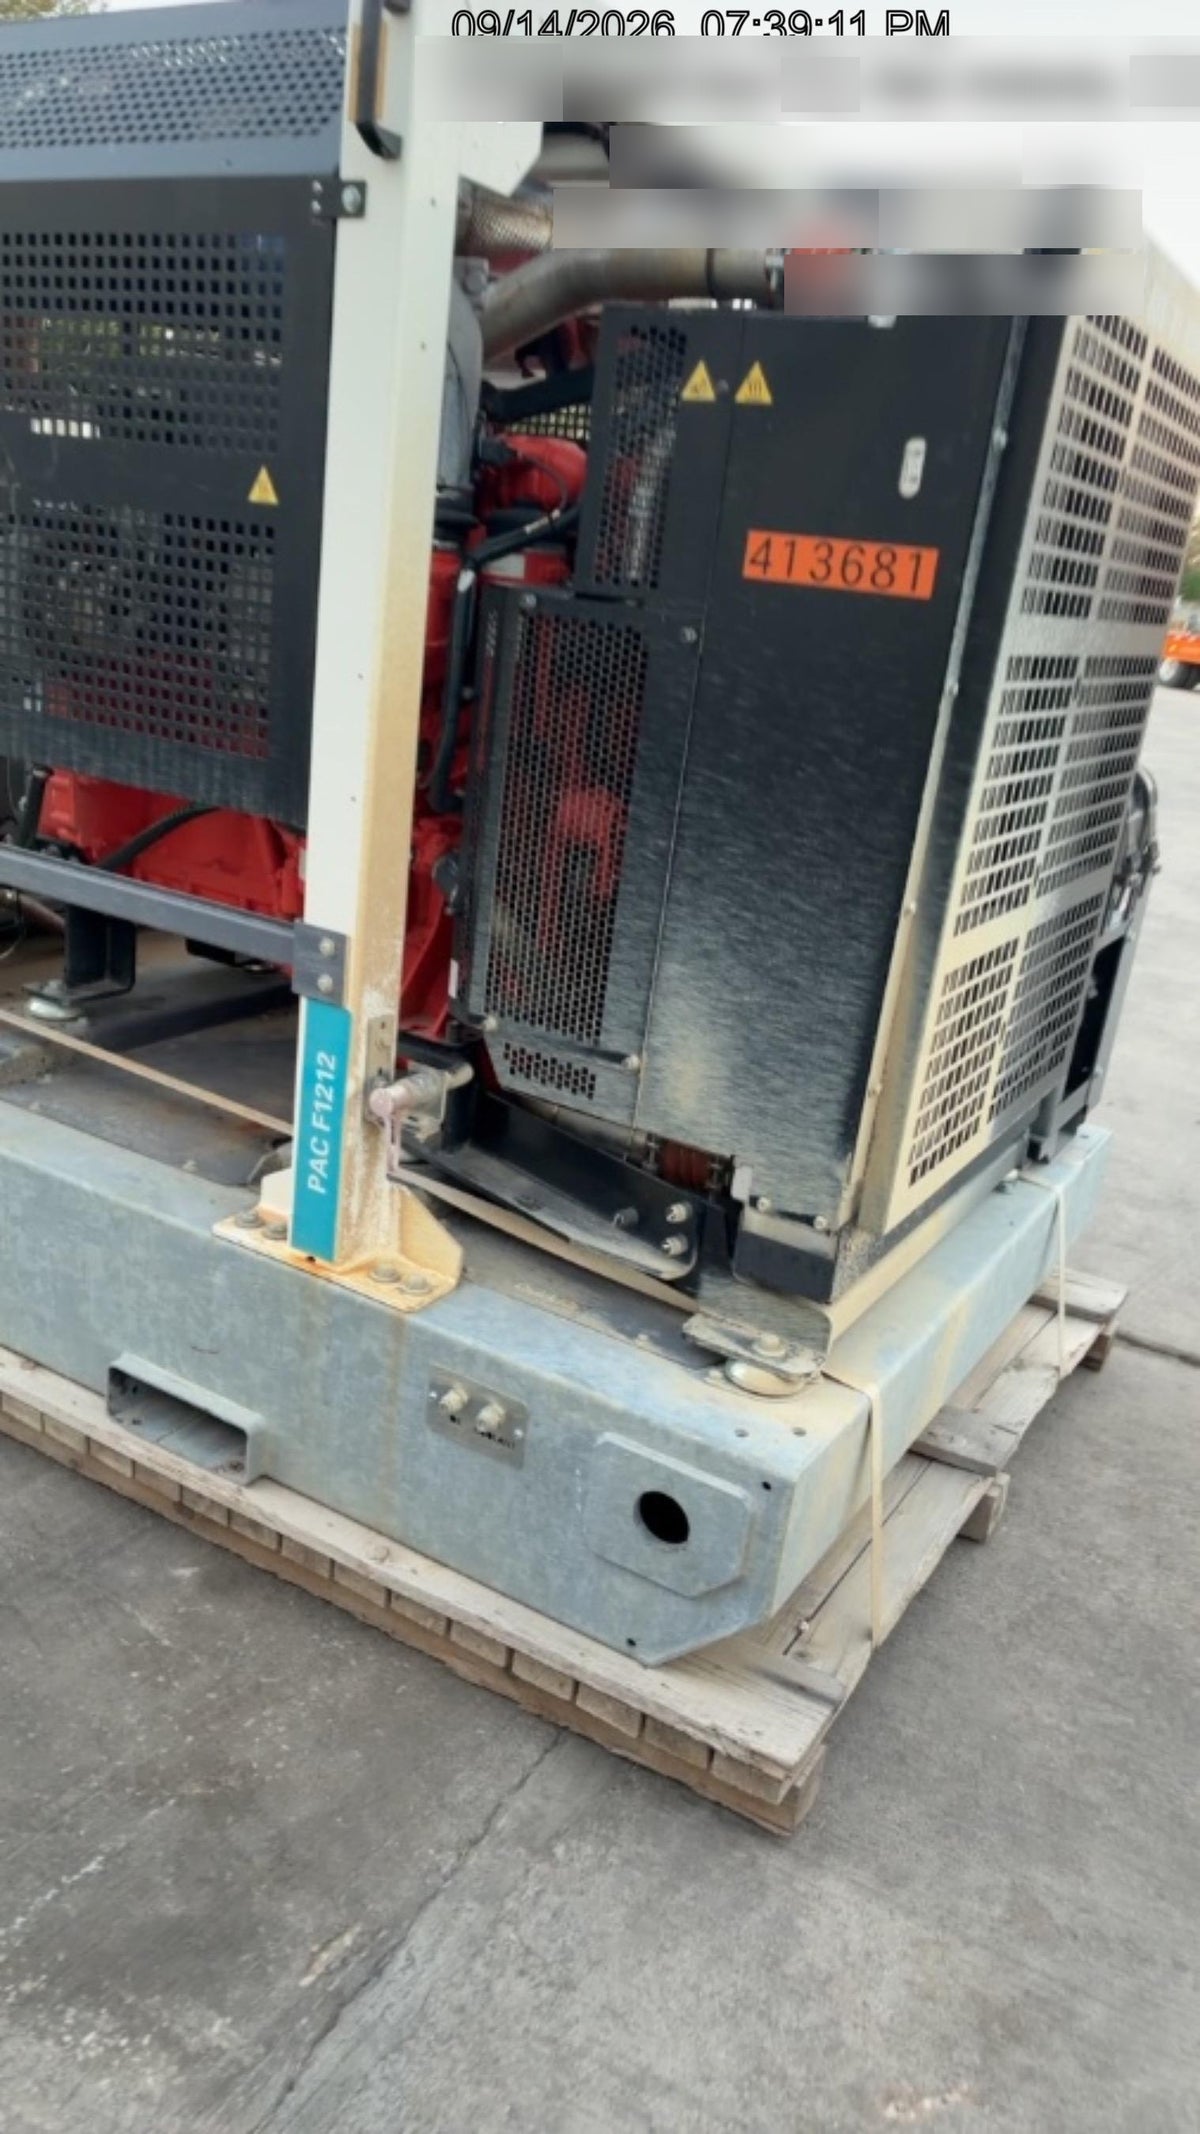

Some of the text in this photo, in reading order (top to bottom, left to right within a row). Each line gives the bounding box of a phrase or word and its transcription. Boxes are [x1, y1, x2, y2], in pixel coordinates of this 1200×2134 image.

[750, 537, 924, 591] 413681
[307, 1052, 336, 1194] PAC F1212
